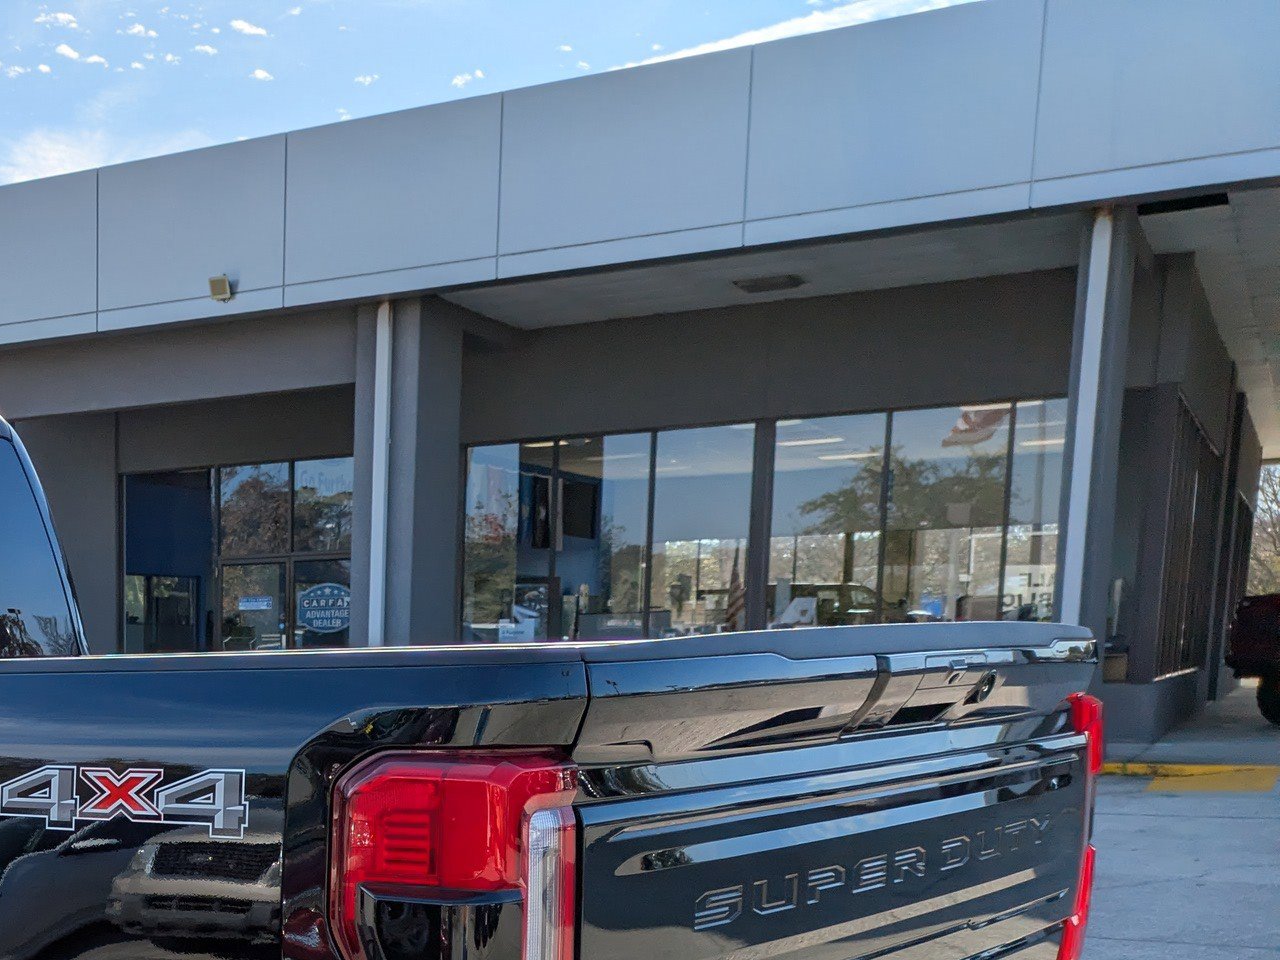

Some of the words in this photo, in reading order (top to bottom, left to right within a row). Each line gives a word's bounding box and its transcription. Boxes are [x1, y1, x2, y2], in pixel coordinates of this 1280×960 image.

[305, 609, 350, 619] ADVANTAGE
[312, 618, 342, 628] DEALER
[0, 765, 249, 840] 4X4
[694, 845, 927, 931] SUPER
[940, 814, 1051, 872] DUTY
